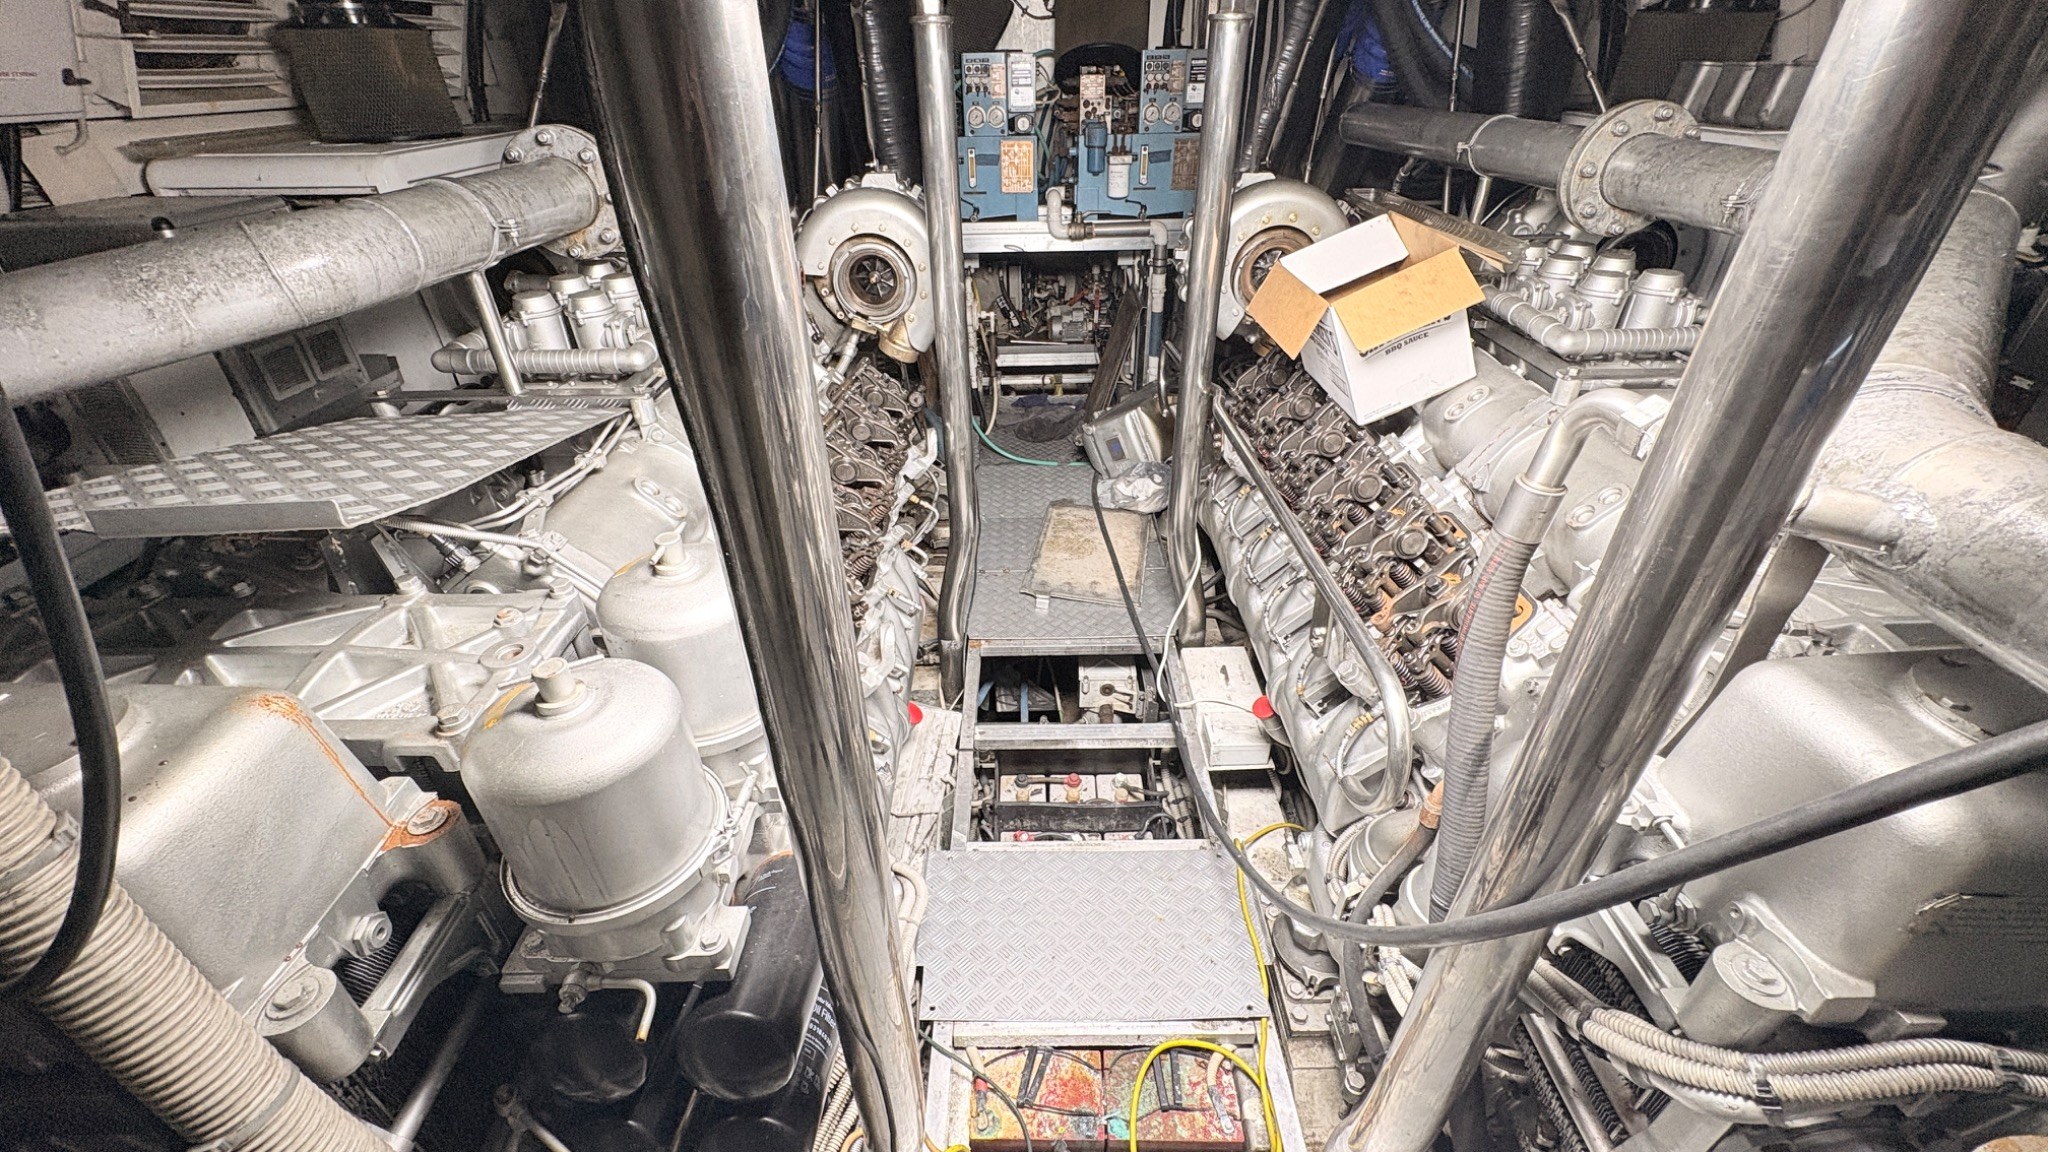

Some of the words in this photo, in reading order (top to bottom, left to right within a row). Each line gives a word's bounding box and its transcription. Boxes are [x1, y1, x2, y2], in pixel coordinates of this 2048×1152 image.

[1384, 342, 1403, 356] BBQ
[1403, 331, 1430, 347] SAUCE
[821, 1006, 837, 1029] Filter
